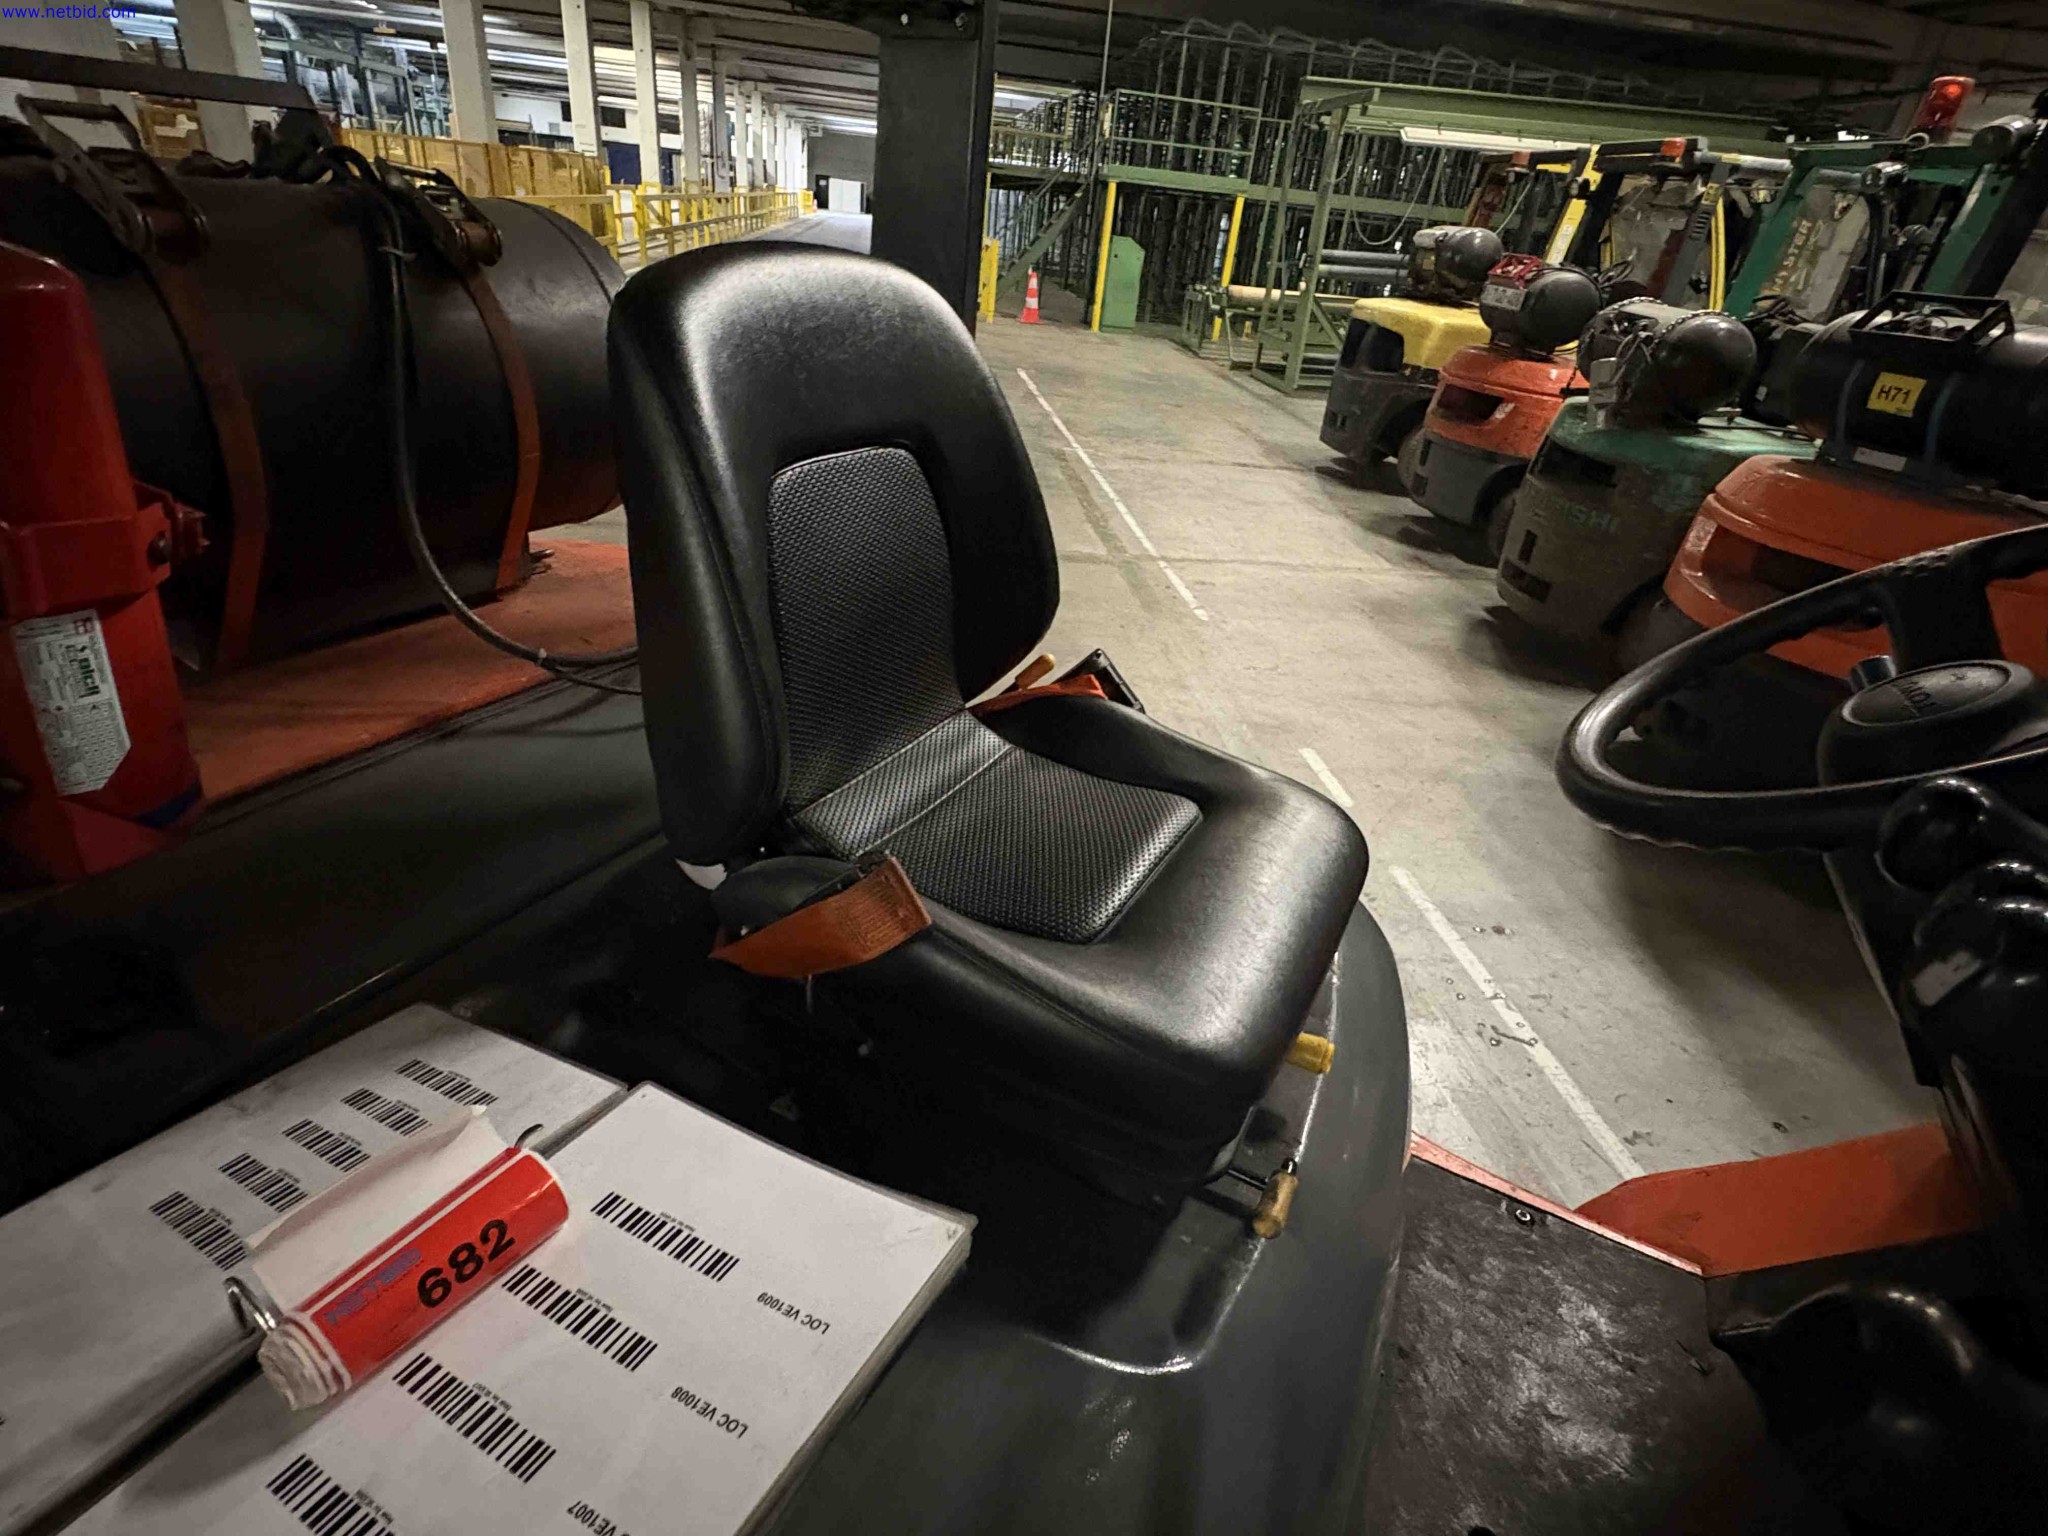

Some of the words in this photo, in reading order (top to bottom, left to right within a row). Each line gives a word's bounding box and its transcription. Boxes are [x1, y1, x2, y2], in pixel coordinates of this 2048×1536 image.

[1877, 385, 1911, 405] H71
[417, 1219, 515, 1308] 682
[757, 1292, 801, 1321] VE1009
[800, 1314, 831, 1335] LOC
[671, 1386, 717, 1422] VE1008
[716, 1413, 749, 1439] LOC
[566, 1500, 617, 1536] VE1007
